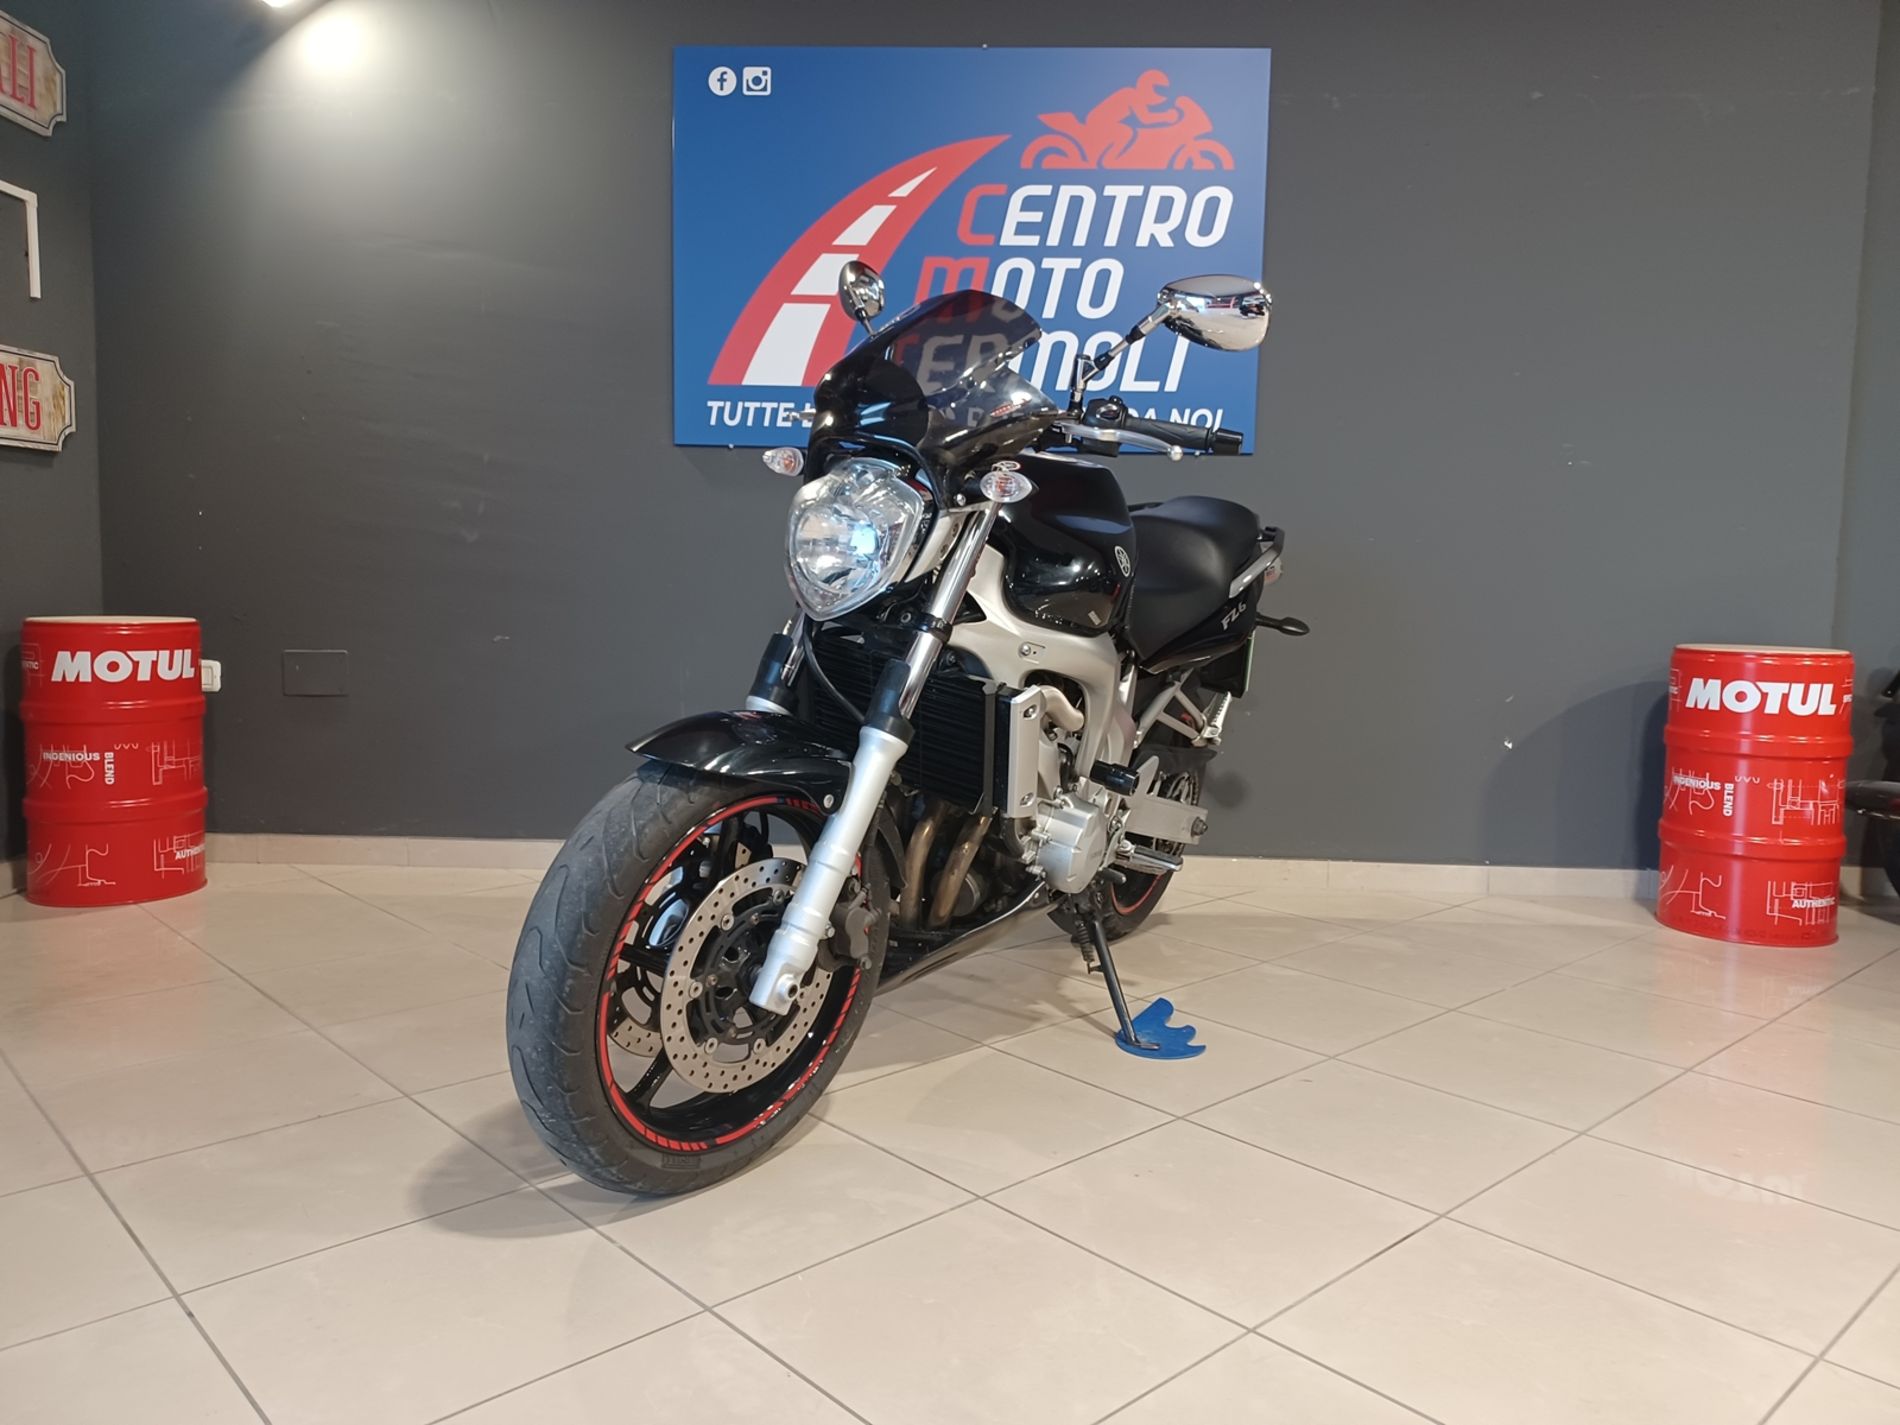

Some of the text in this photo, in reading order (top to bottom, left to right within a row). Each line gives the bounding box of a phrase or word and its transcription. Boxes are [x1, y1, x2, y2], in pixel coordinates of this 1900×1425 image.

[957, 184, 1234, 248] CENTRO
[911, 256, 1125, 324] MOTO
[707, 400, 796, 428] TUTTE
[1221, 601, 1247, 630] FZ6
[51, 648, 195, 683] MOTUL
[1685, 677, 1837, 716] MOTUL
[104, 752, 115, 785] BLEND
[1722, 783, 1735, 817] BLEND
